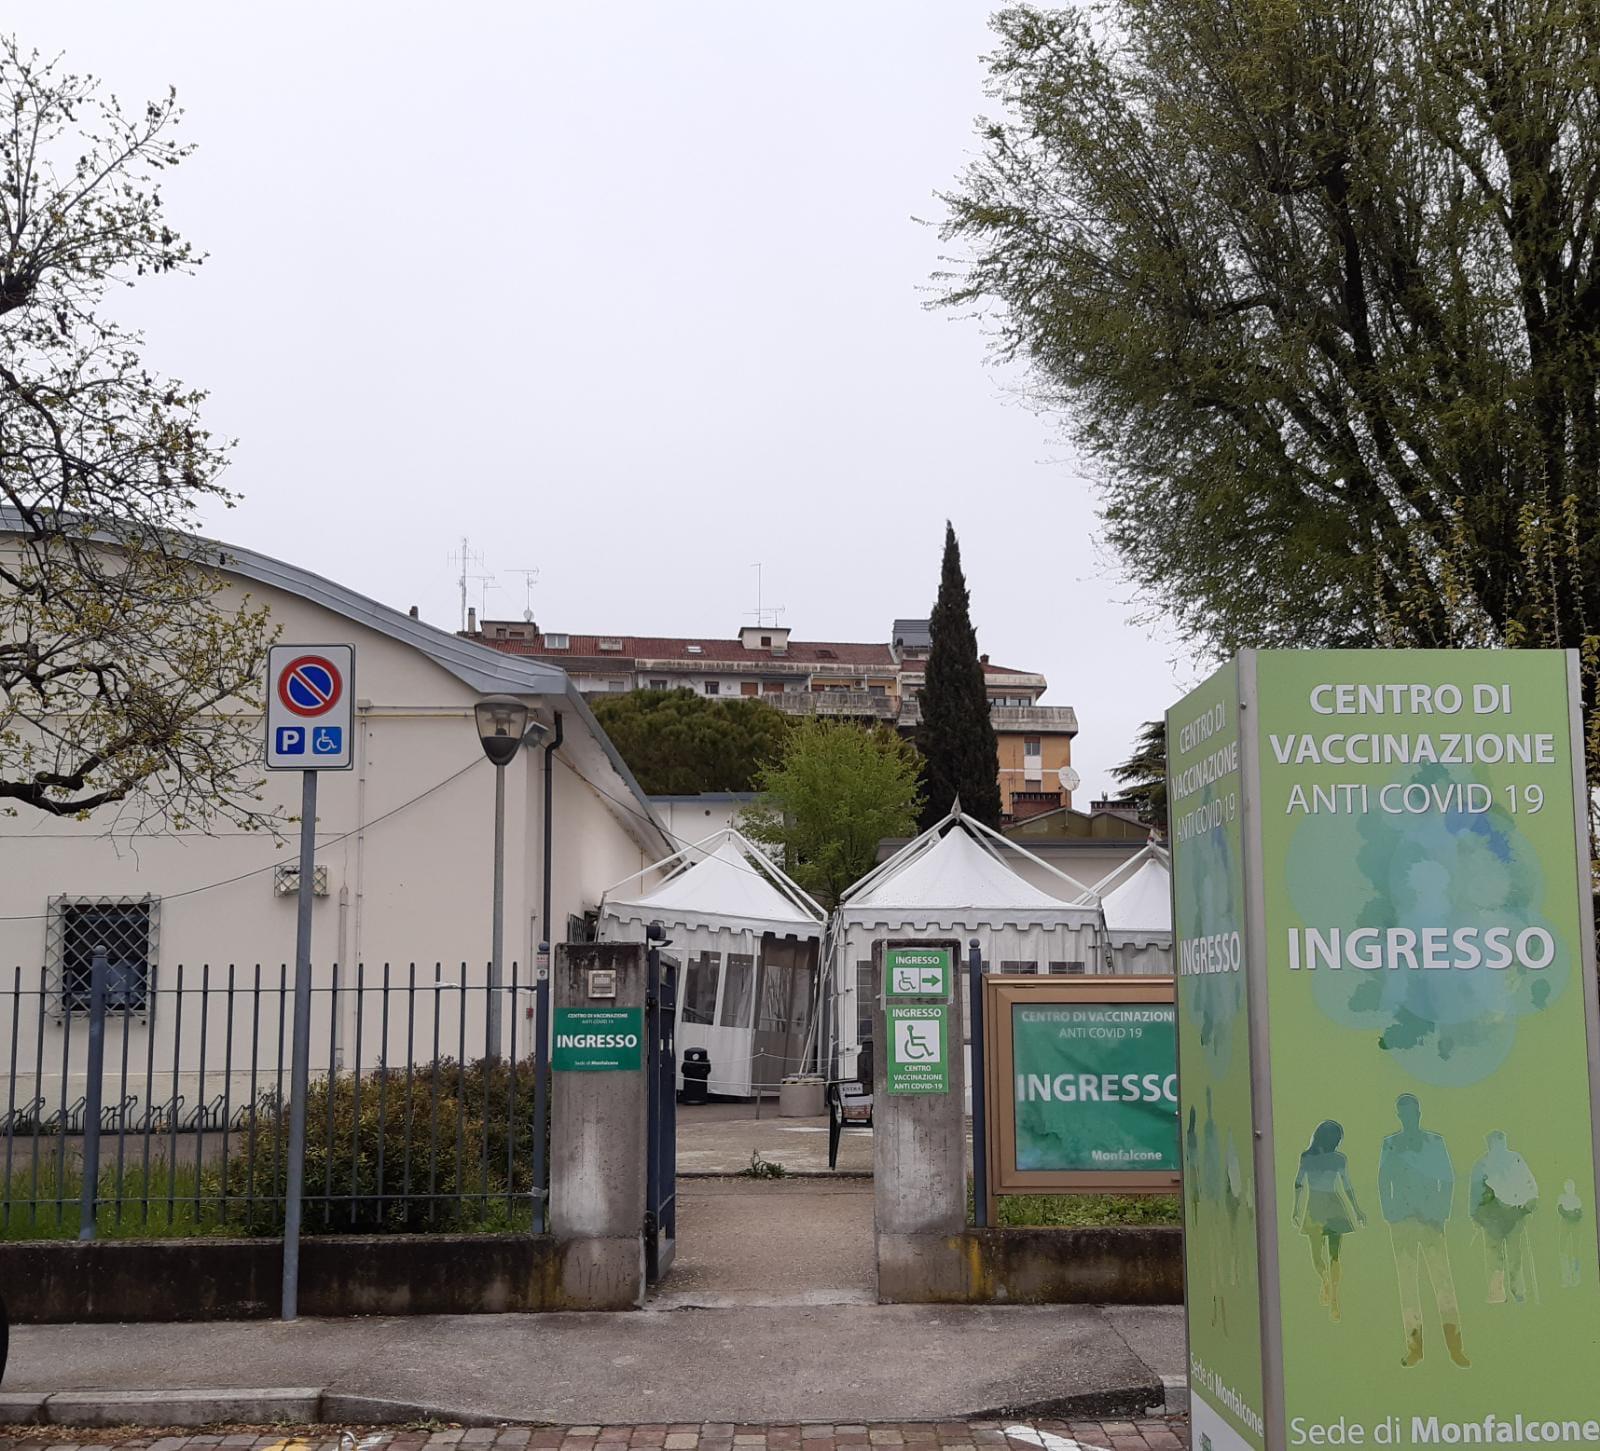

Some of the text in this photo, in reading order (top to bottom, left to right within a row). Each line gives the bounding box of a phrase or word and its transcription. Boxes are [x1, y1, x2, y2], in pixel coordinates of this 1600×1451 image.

[1309, 684, 1512, 715] CENTRO DI
[282, 730, 300, 751] P
[1180, 700, 1226, 754] CENTRO DI
[1269, 734, 1555, 764] VACCINAZIONE
[1172, 741, 1238, 801] VACCINAZIONE
[1285, 783, 1545, 814] ANTI COVID 19
[1177, 792, 1235, 842] ANTI COVID 19
[895, 956, 940, 965] INGRESSO
[1180, 931, 1241, 976] INGRESSO
[1287, 927, 1556, 970] INGRESSO
[892, 1008, 942, 1018] INGRESSO
[1022, 1011, 1070, 1022] CENTRO
[1073, 1011, 1086, 1022] DI
[557, 1034, 638, 1048] INGRESSO
[1059, 1028, 1142, 1038] ANTI COVID 19
[1092, 1149, 1162, 1161] Monfalcone
[1191, 1352, 1264, 1437] Sede di Monfalcone
[1290, 1414, 1600, 1444] Sede di Monfalcone
